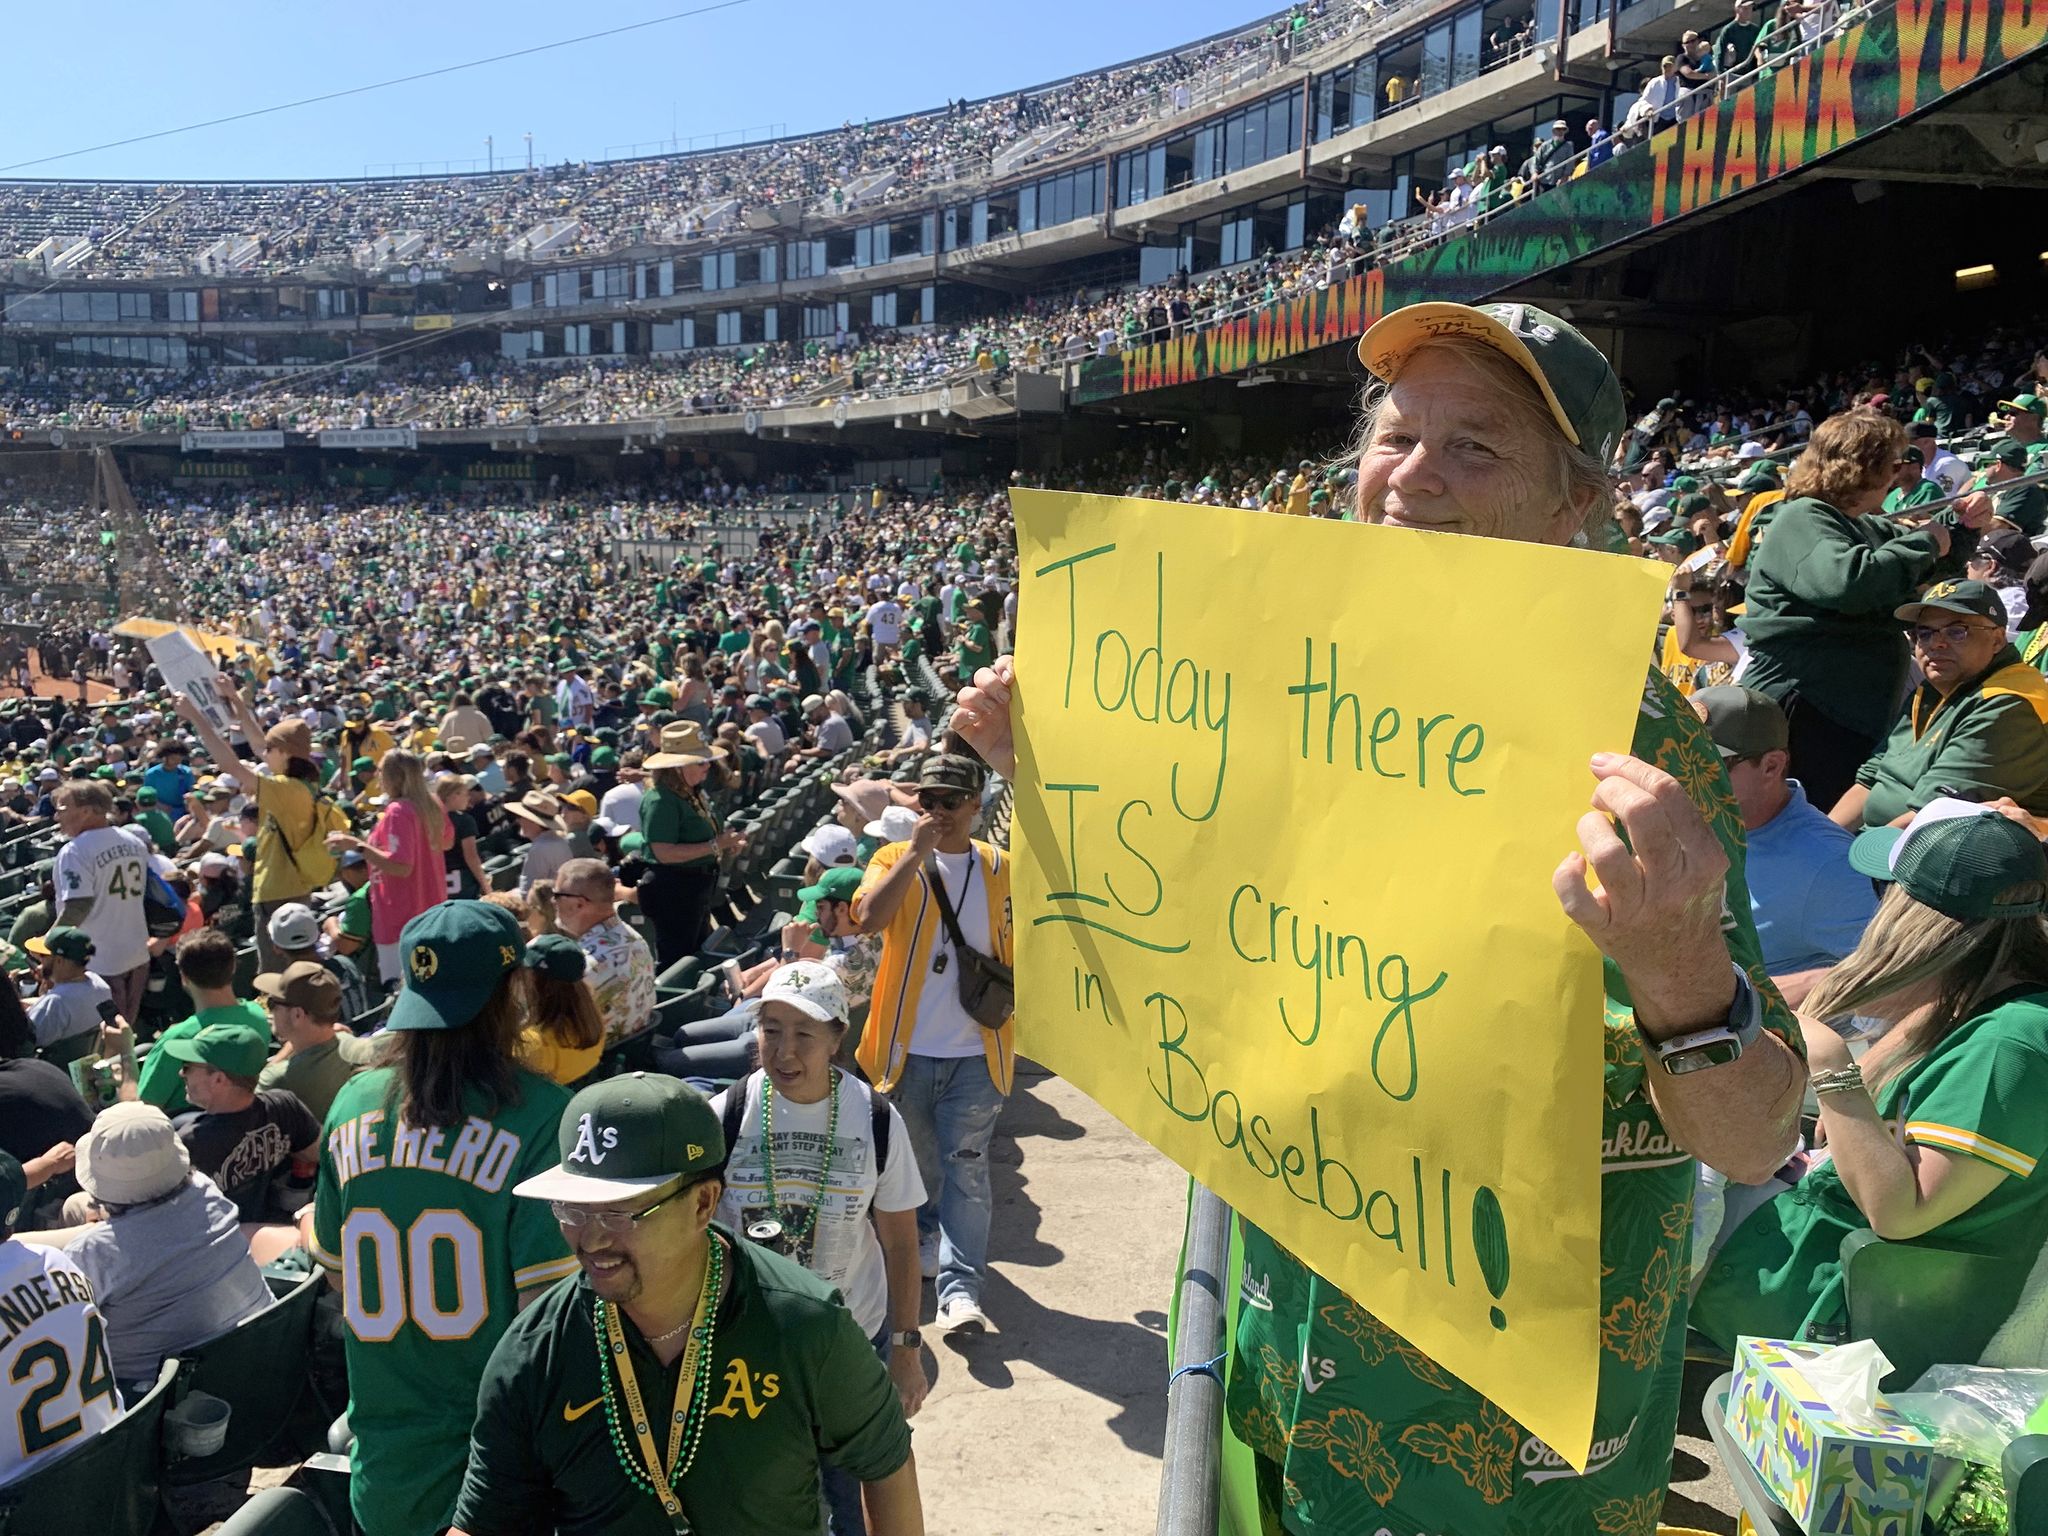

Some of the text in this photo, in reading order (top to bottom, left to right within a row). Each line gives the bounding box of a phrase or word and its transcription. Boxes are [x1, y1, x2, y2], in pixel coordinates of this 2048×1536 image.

[1650, 22, 1866, 226] THANK
[1120, 333, 1197, 394] THANK
[1206, 318, 1250, 377] YOU
[1256, 268, 1385, 365] OAKLAND
[1036, 543, 1486, 822] Today there
[109, 860, 142, 900] 43
[1045, 783, 1449, 1103] IS crying
[328, 1108, 387, 1191] THE
[391, 1114, 521, 1194] HERD
[567, 1112, 620, 1166] A's
[792, 1141, 815, 1152] STEP
[817, 1144, 845, 1156] AAY
[1074, 947, 1510, 1332] in Baseball!
[341, 1207, 489, 1342] 00
[8, 1312, 119, 1460] 24
[707, 1358, 780, 1420] A's
[1519, 1416, 1638, 1468] Oaand
